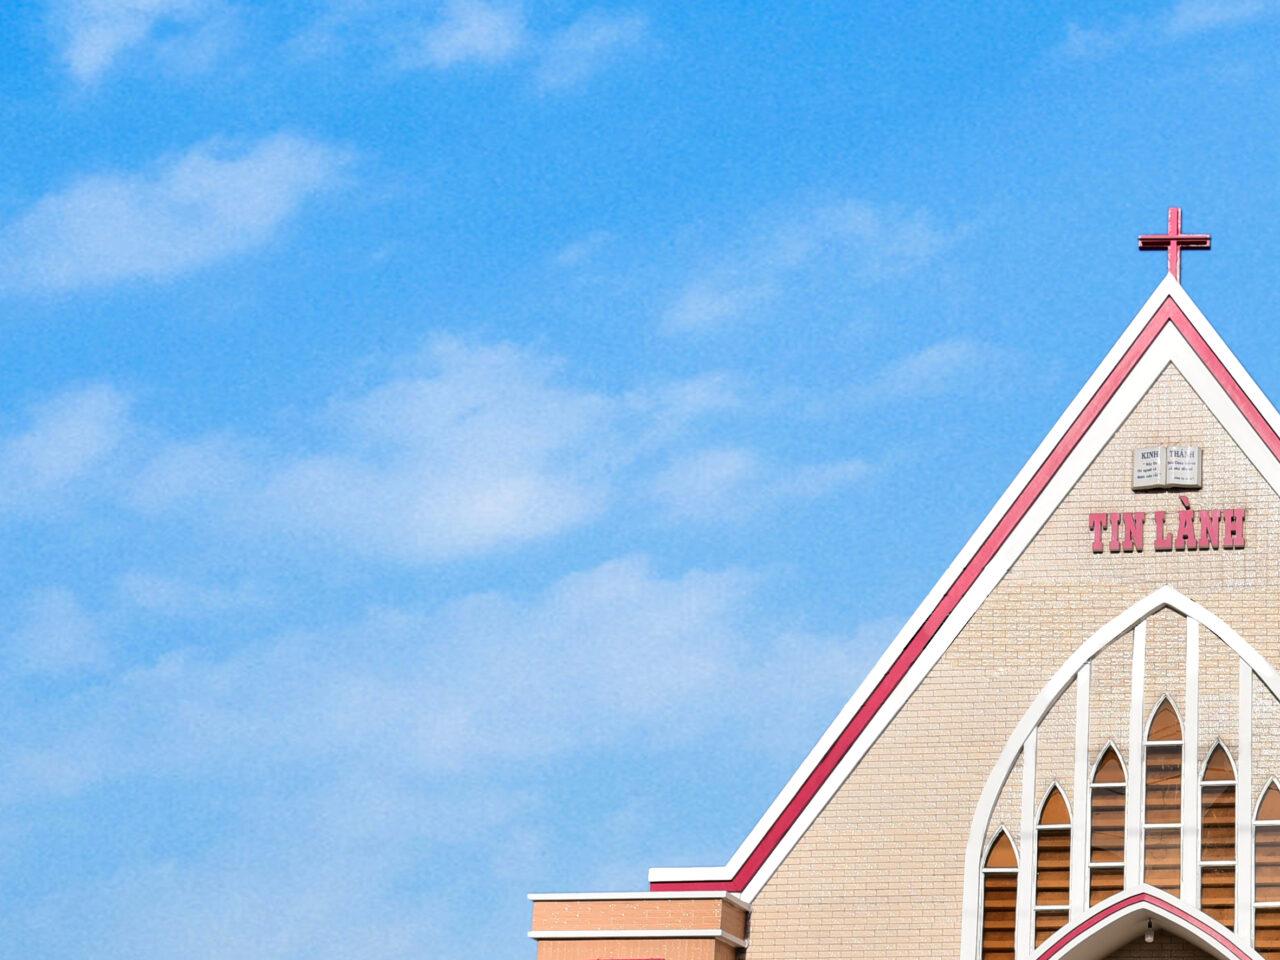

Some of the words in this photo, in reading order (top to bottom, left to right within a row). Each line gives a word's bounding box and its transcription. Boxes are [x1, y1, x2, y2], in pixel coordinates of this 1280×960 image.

[1141, 450, 1159, 459] KINH
[1089, 512, 1146, 553] TIN
[1154, 495, 1246, 551] LÀNH
